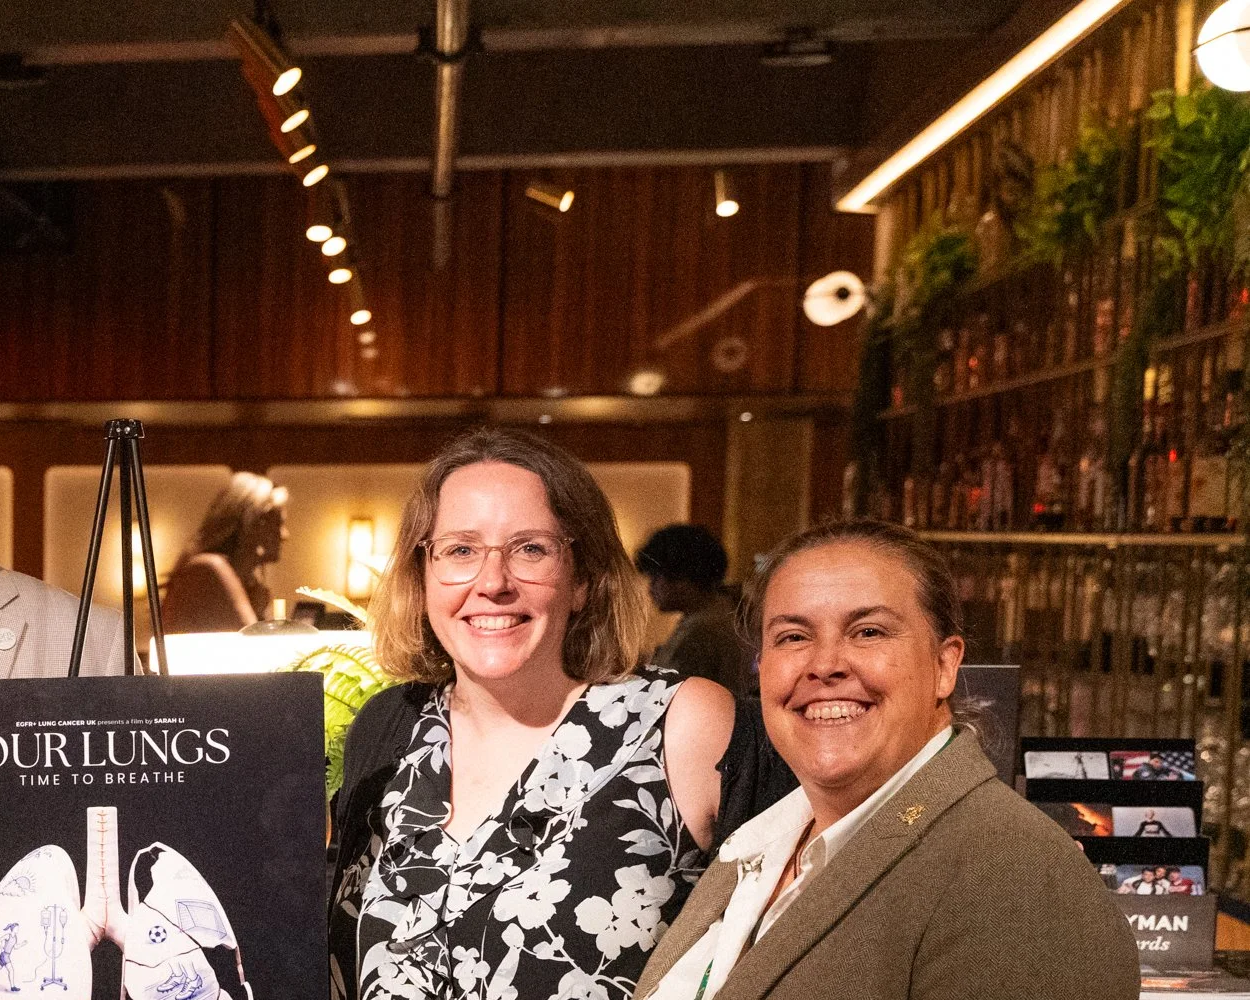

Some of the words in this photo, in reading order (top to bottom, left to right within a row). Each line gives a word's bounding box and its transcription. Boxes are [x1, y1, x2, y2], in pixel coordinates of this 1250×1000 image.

[82, 728, 230, 767] LUNGS
[19, 774, 60, 786] TIME
[72, 774, 94, 785] TO
[105, 771, 185, 784] BREATHE
